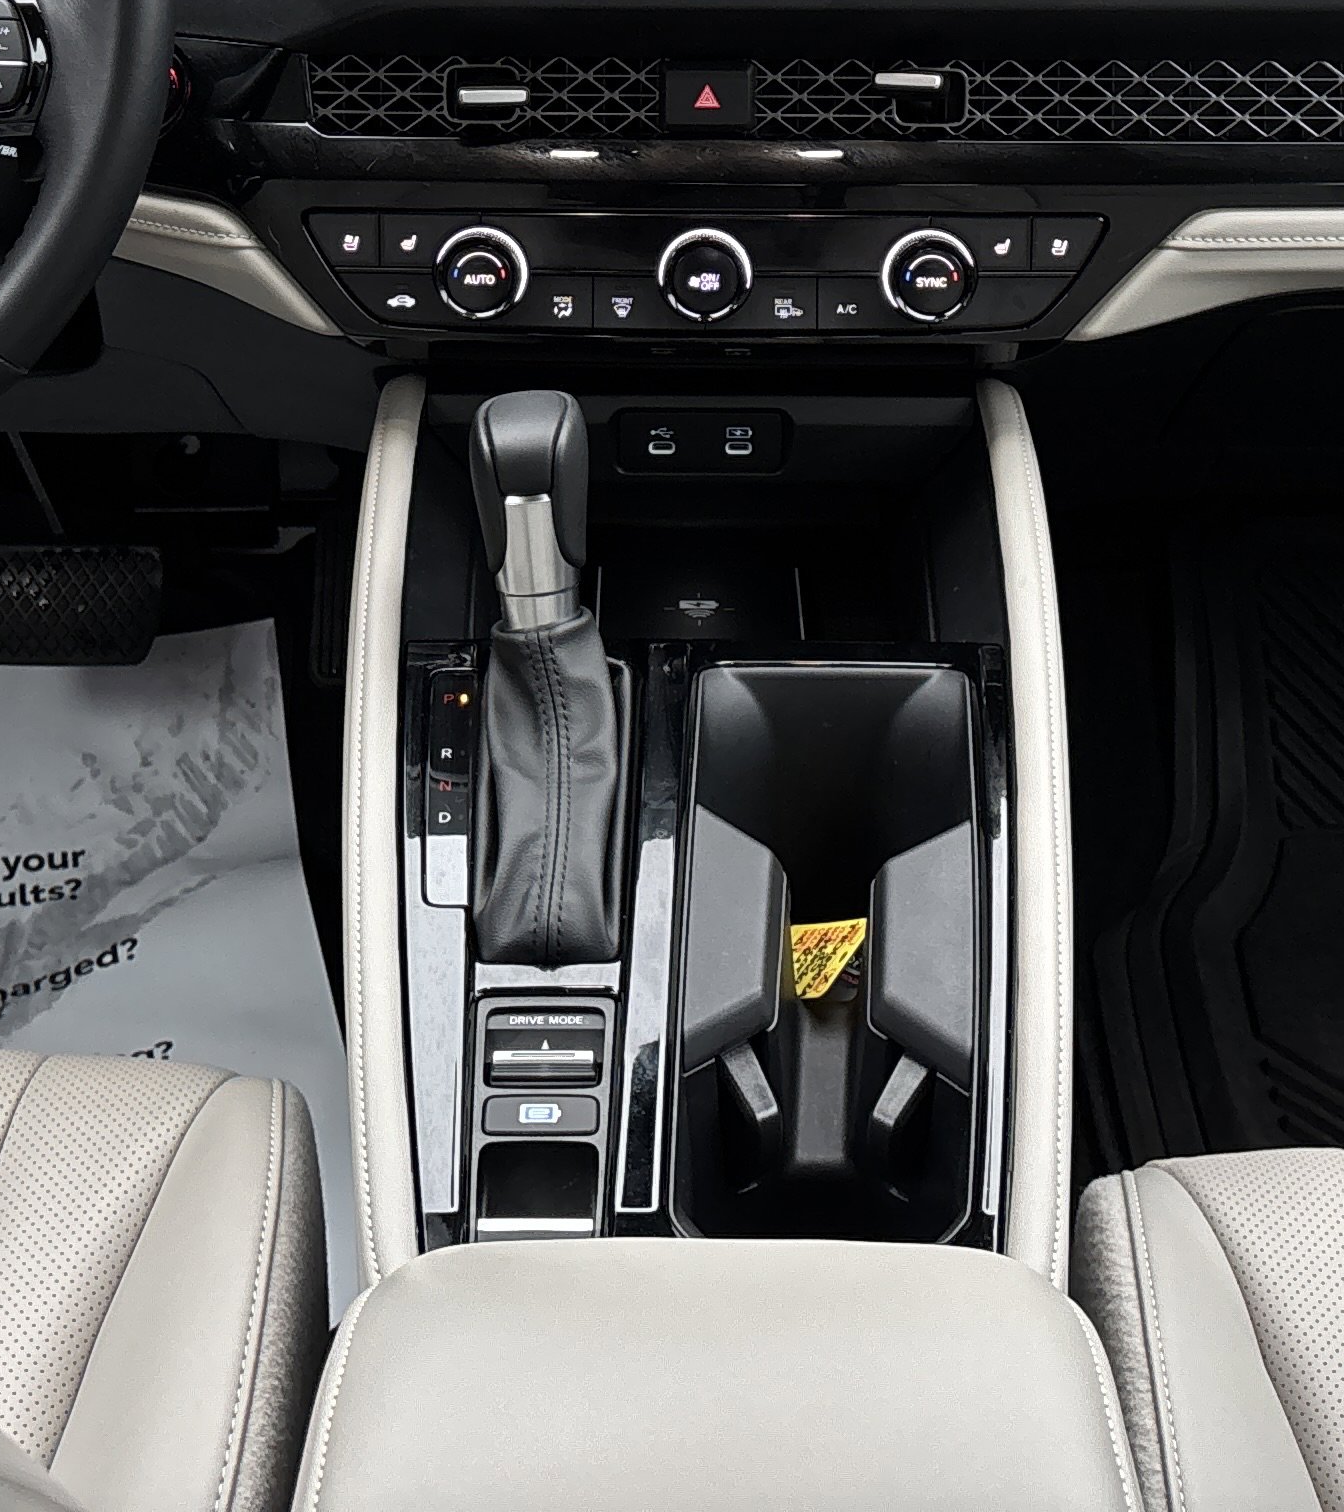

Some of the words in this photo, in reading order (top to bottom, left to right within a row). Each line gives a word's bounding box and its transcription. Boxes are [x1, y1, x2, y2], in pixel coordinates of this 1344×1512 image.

[463, 274, 496, 285] AUTO
[915, 276, 948, 288] SYNC
[700, 282, 720, 291] OFF
[836, 304, 858, 315] A/C
[443, 693, 455, 705] P
[440, 748, 453, 759] R
[439, 778, 452, 792] N
[438, 812, 452, 824] D
[1, 848, 87, 881] your
[509, 1015, 545, 1025] DRIVE
[548, 1015, 584, 1025] MODE
